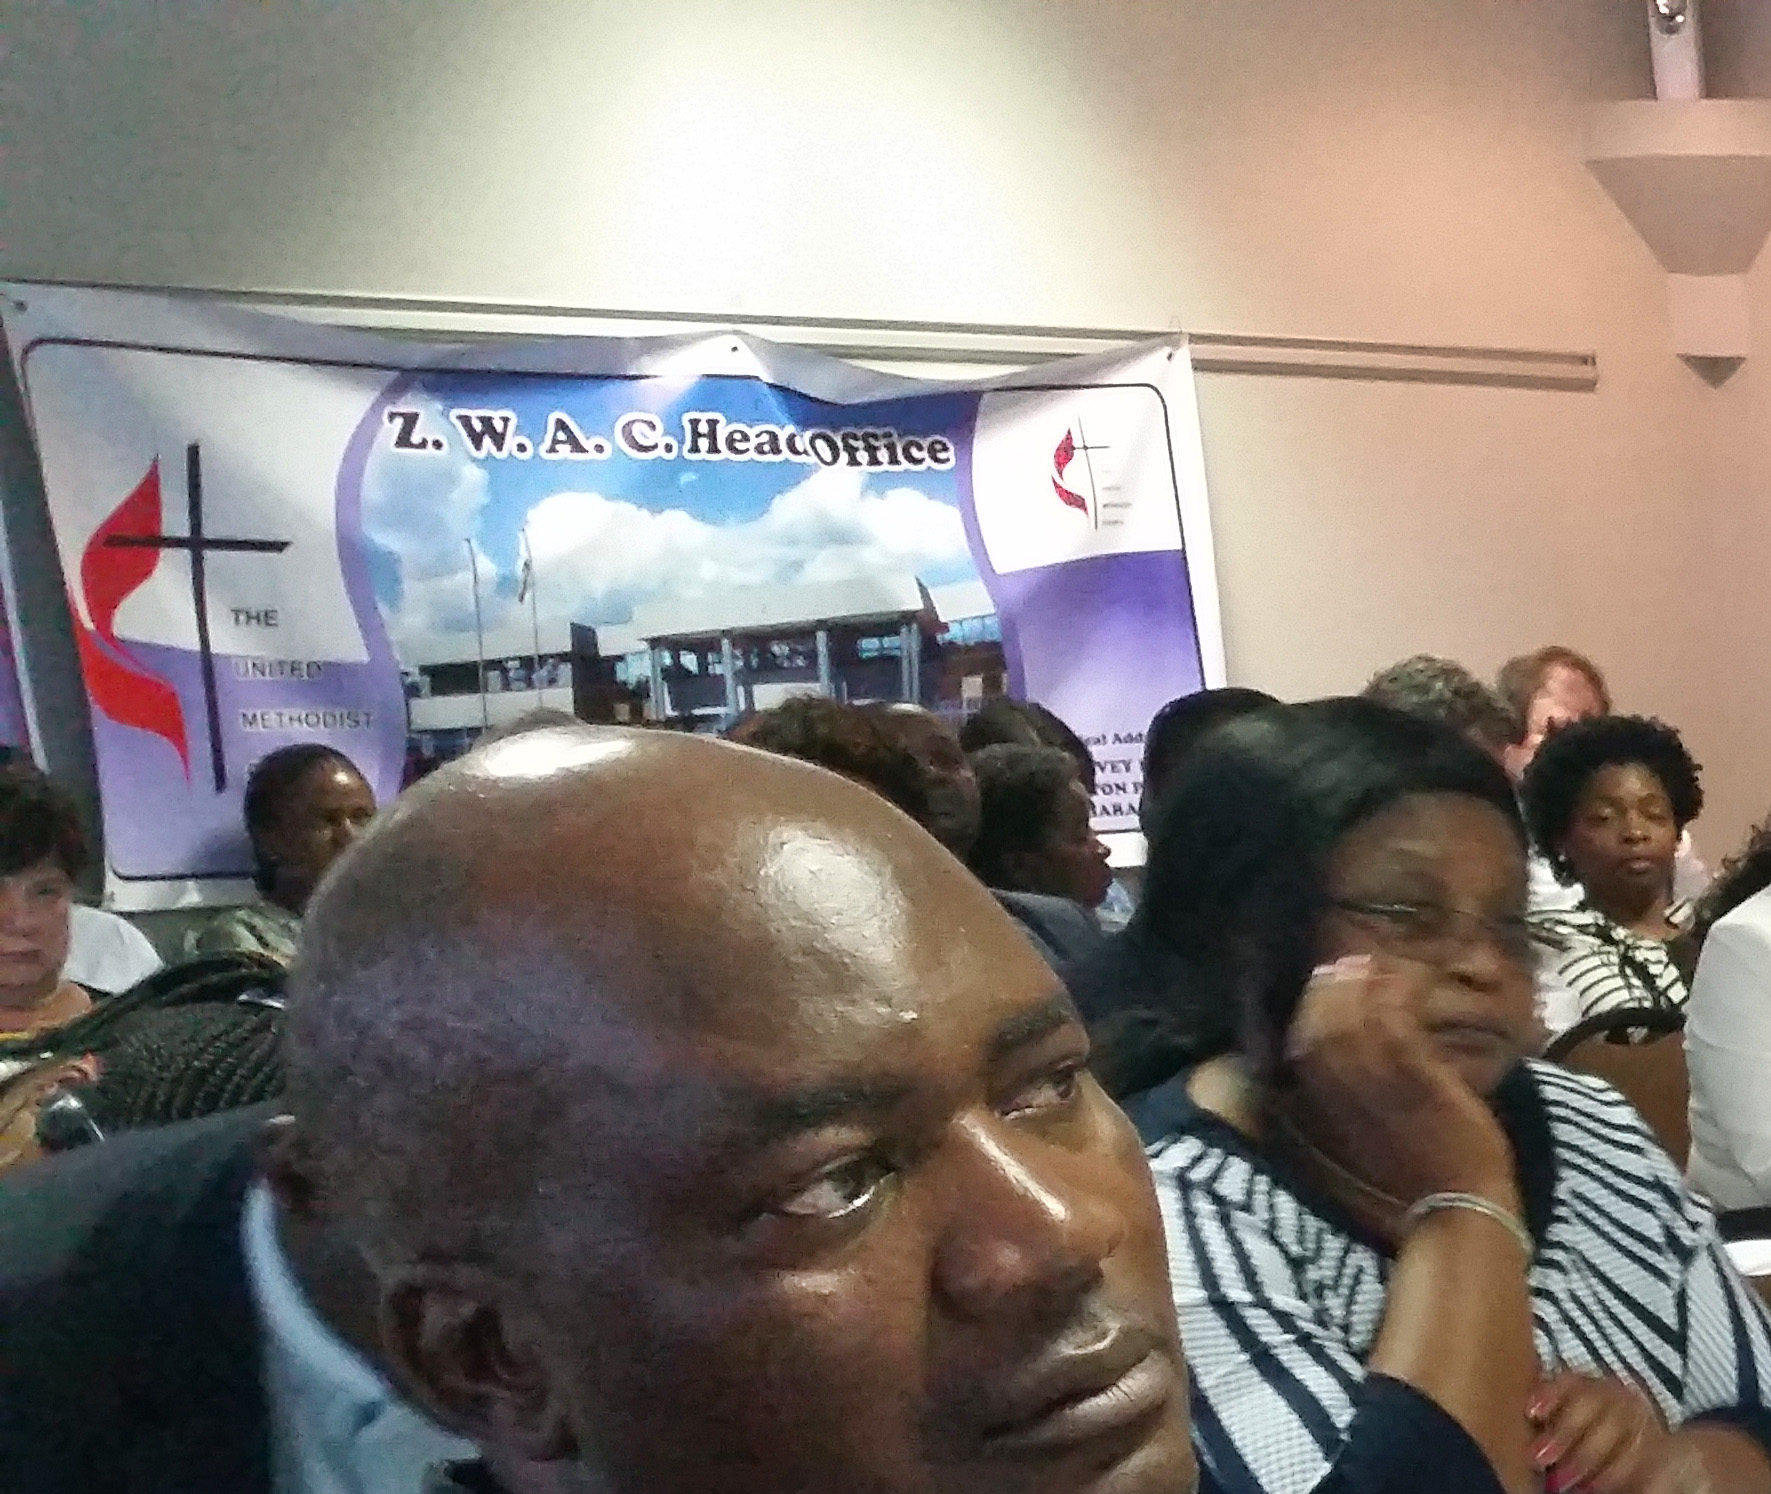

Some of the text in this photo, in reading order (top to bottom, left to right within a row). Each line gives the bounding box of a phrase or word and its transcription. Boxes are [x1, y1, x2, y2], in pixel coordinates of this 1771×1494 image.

[387, 410, 444, 451] Z.
[455, 413, 528, 454] W.
[544, 416, 606, 455] A.
[620, 417, 674, 455] C.
[809, 429, 951, 468] Office
[230, 608, 279, 628] THE
[232, 659, 322, 679] UNITED
[241, 711, 373, 729] METHODIST
[1093, 759, 1132, 773] VEY
